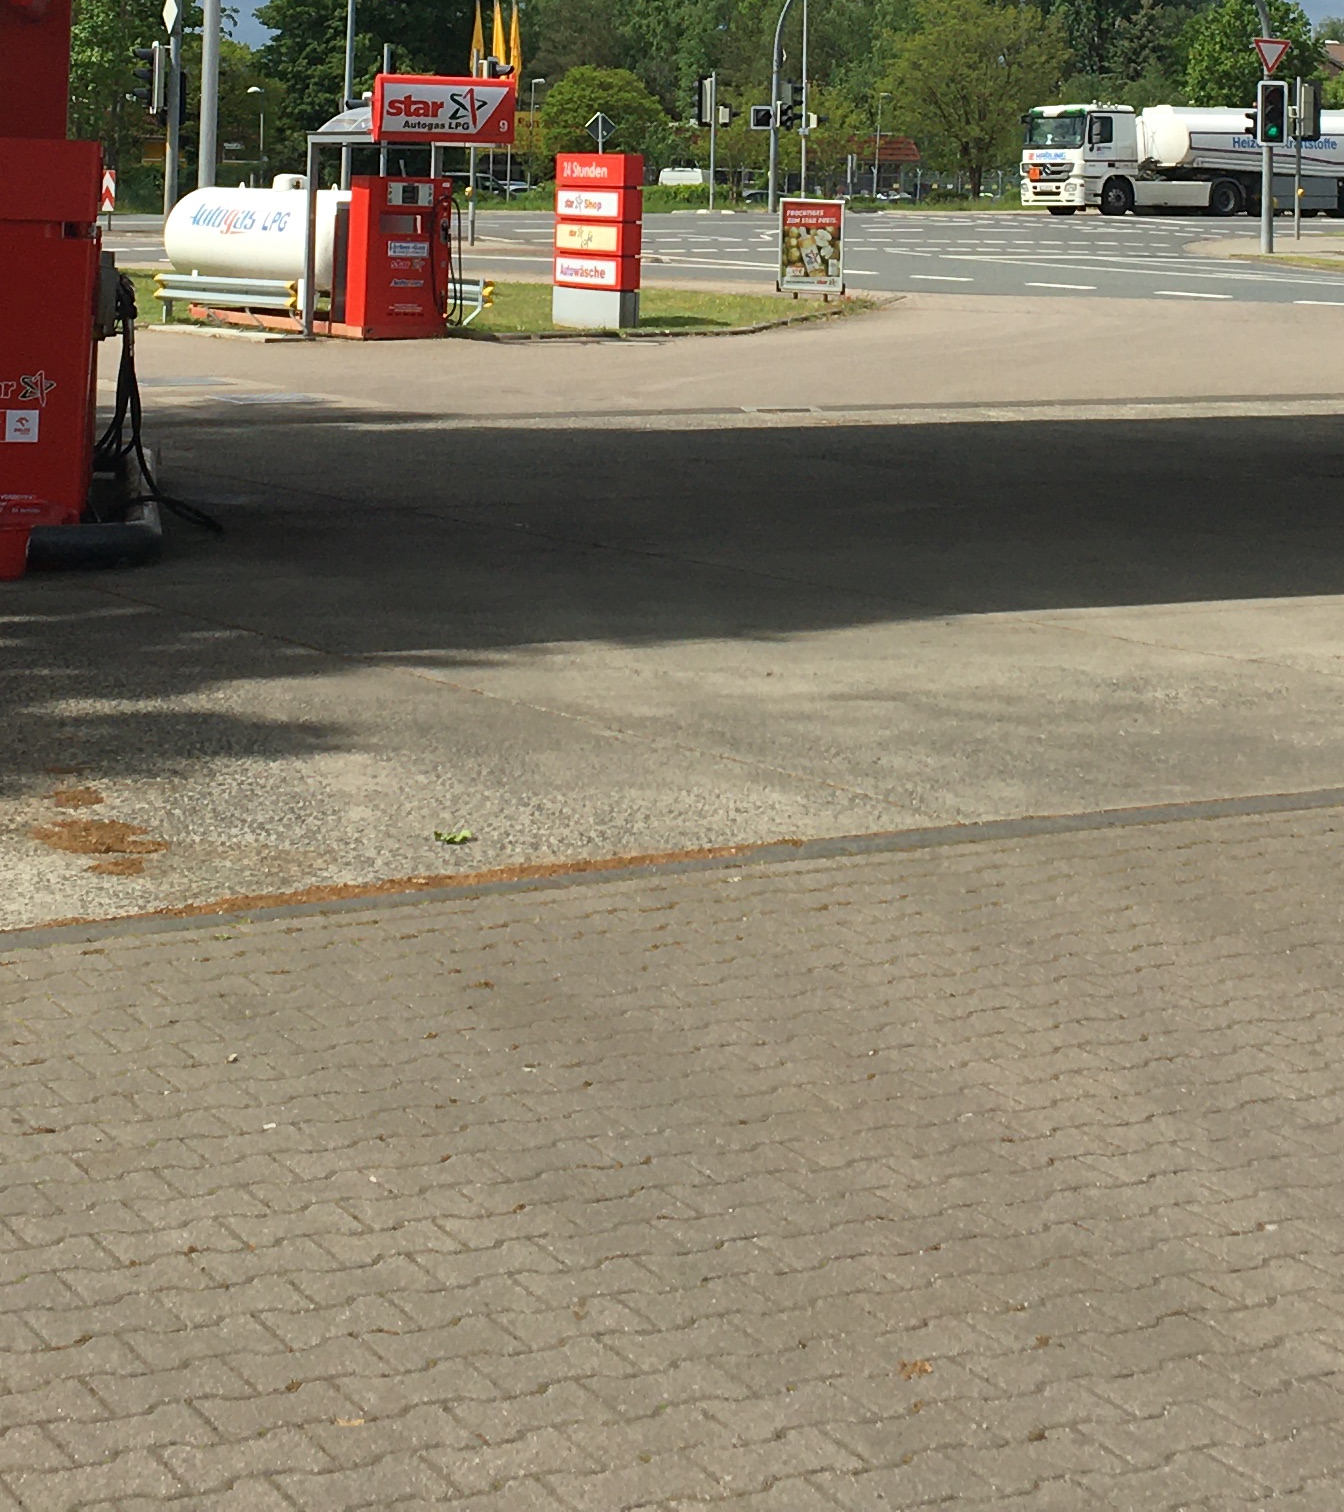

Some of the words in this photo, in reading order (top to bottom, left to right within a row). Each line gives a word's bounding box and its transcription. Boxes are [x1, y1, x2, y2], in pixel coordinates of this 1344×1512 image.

[386, 95, 445, 118] star
[403, 120, 446, 132] Autogas
[448, 121, 470, 131] LPG
[499, 121, 508, 132] 9
[572, 161, 608, 178] Stunden
[584, 199, 602, 212] Shop
[190, 203, 257, 235] Autogas
[261, 211, 291, 233] LPG
[560, 263, 606, 279] Autowäsche
